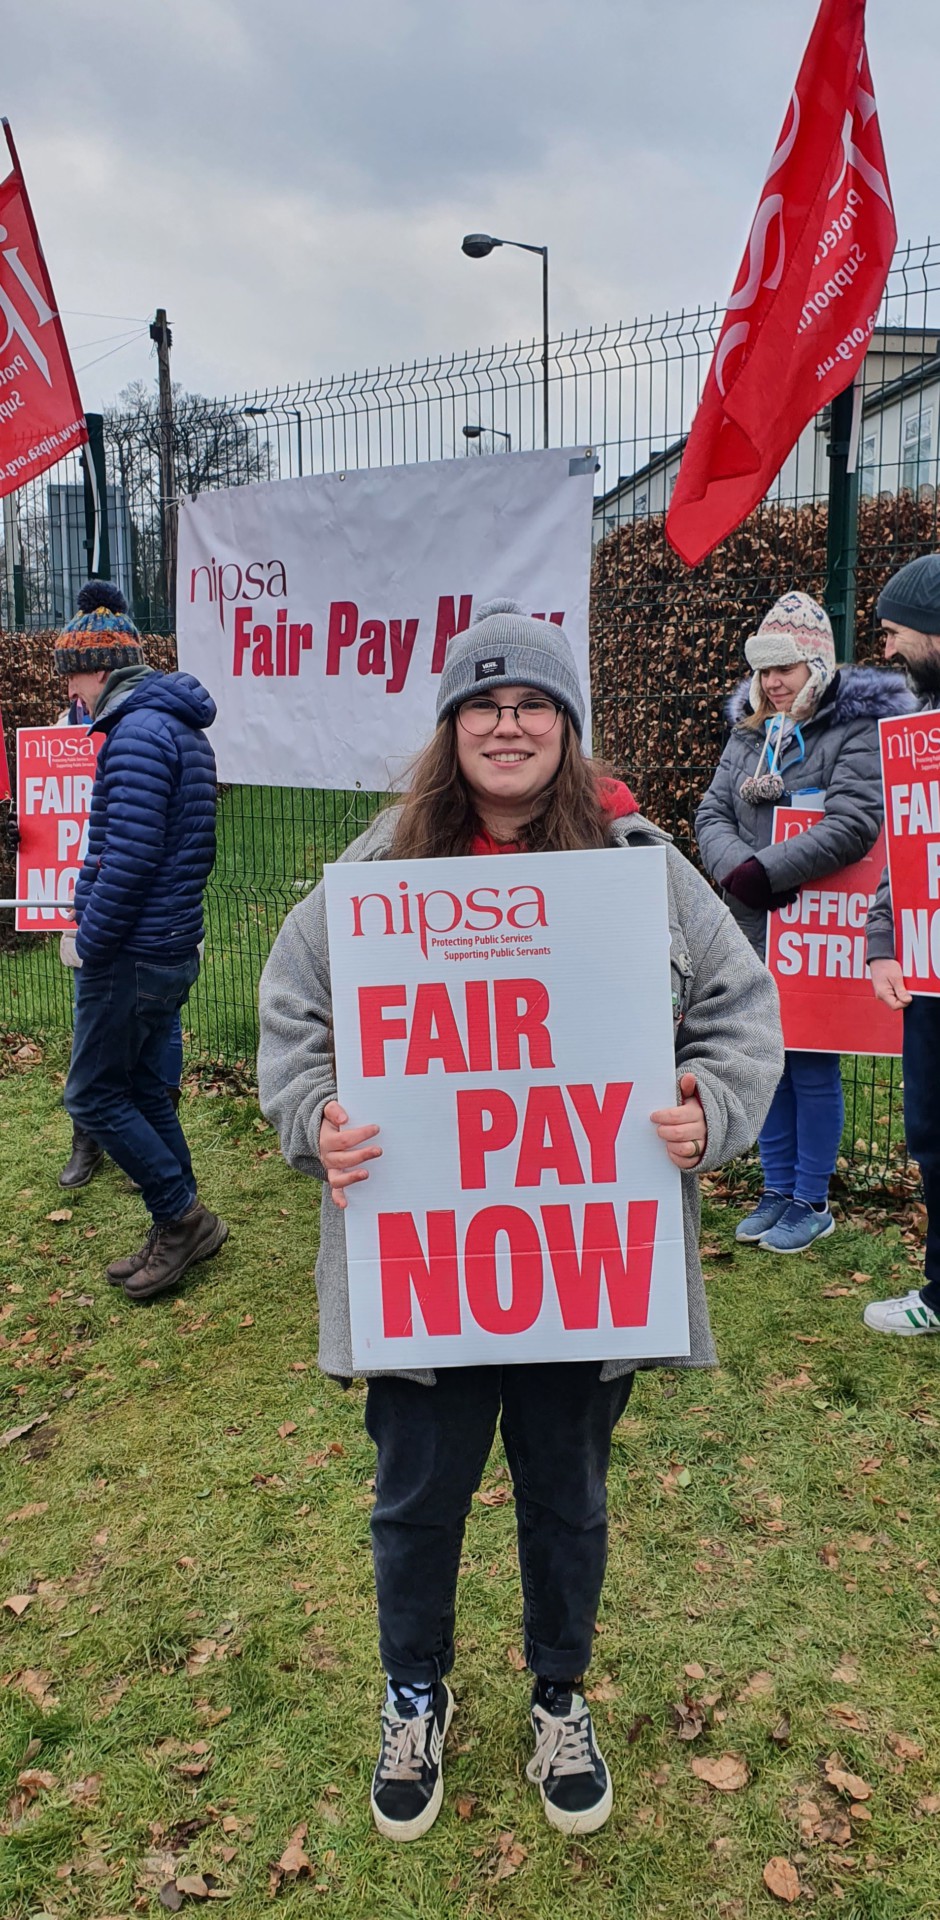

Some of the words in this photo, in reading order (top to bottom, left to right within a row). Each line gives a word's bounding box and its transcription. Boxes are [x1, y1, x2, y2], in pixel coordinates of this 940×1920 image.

[190, 556, 288, 633] nipsa
[232, 606, 313, 677] Fair
[325, 600, 420, 694] Pay
[24, 735, 95, 768] nipsa
[887, 726, 940, 770] nips
[25, 775, 94, 814] FAIR
[891, 780, 940, 837] FAI
[27, 866, 80, 920] NO
[778, 890, 877, 928] OFFIC
[350, 881, 549, 960] nipsa
[431, 937, 473, 947] Protecting
[474, 935, 499, 945] Public
[500, 933, 533, 944] Services
[444, 950, 489, 961] Supporting
[490, 947, 515, 958] Public
[516, 946, 551, 957] Servants
[776, 931, 872, 979] STRI
[358, 978, 556, 1077] FAIR
[456, 1081, 634, 1190] PAY
[377, 1200, 658, 1338] NOW
